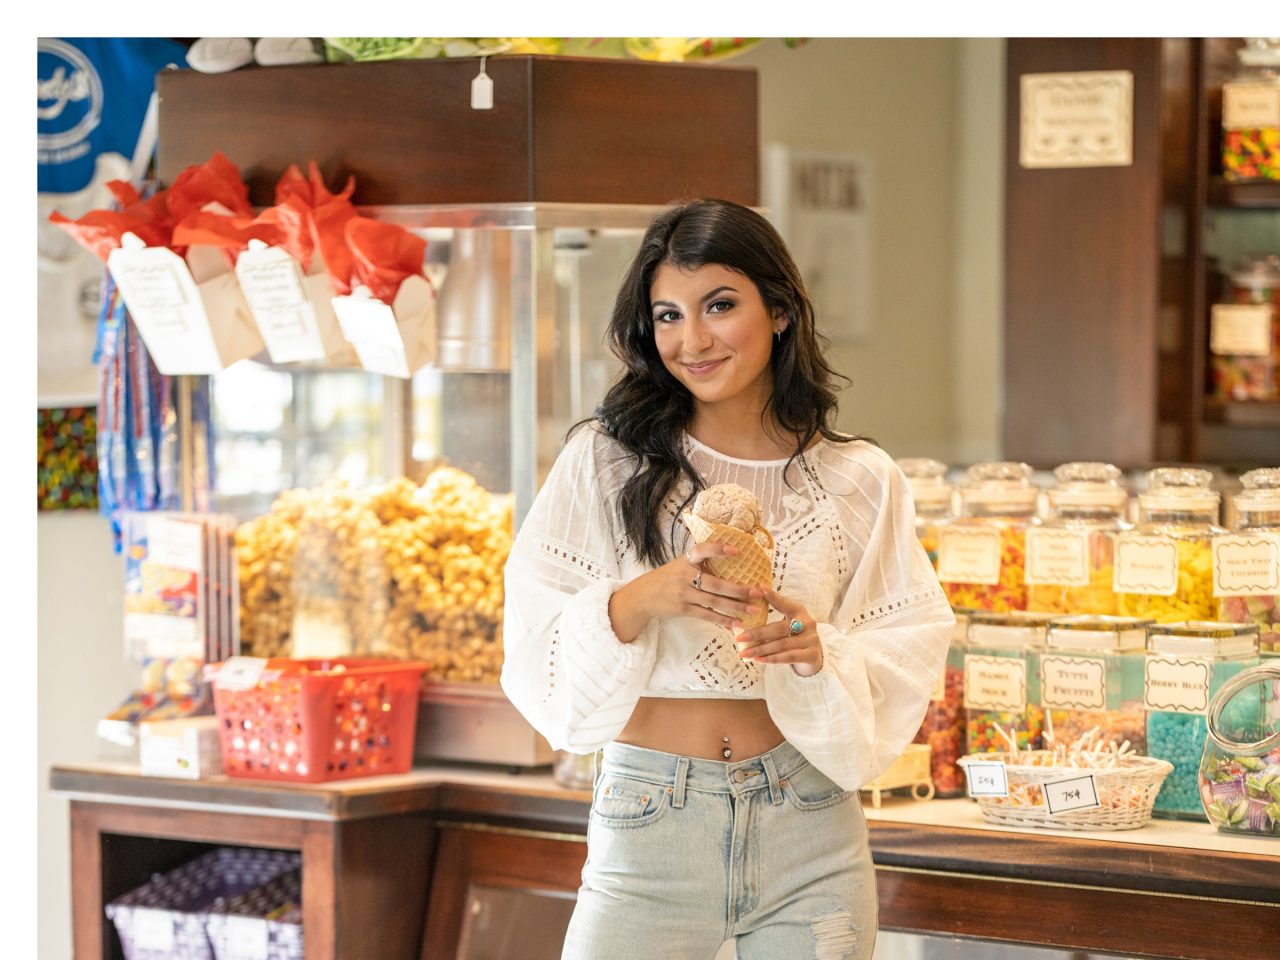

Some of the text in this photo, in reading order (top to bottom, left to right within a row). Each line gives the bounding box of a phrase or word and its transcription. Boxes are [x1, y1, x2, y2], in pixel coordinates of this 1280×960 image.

[1057, 669, 1089, 681] TUTTI
[1150, 679, 1204, 691] BERRY BLUE
